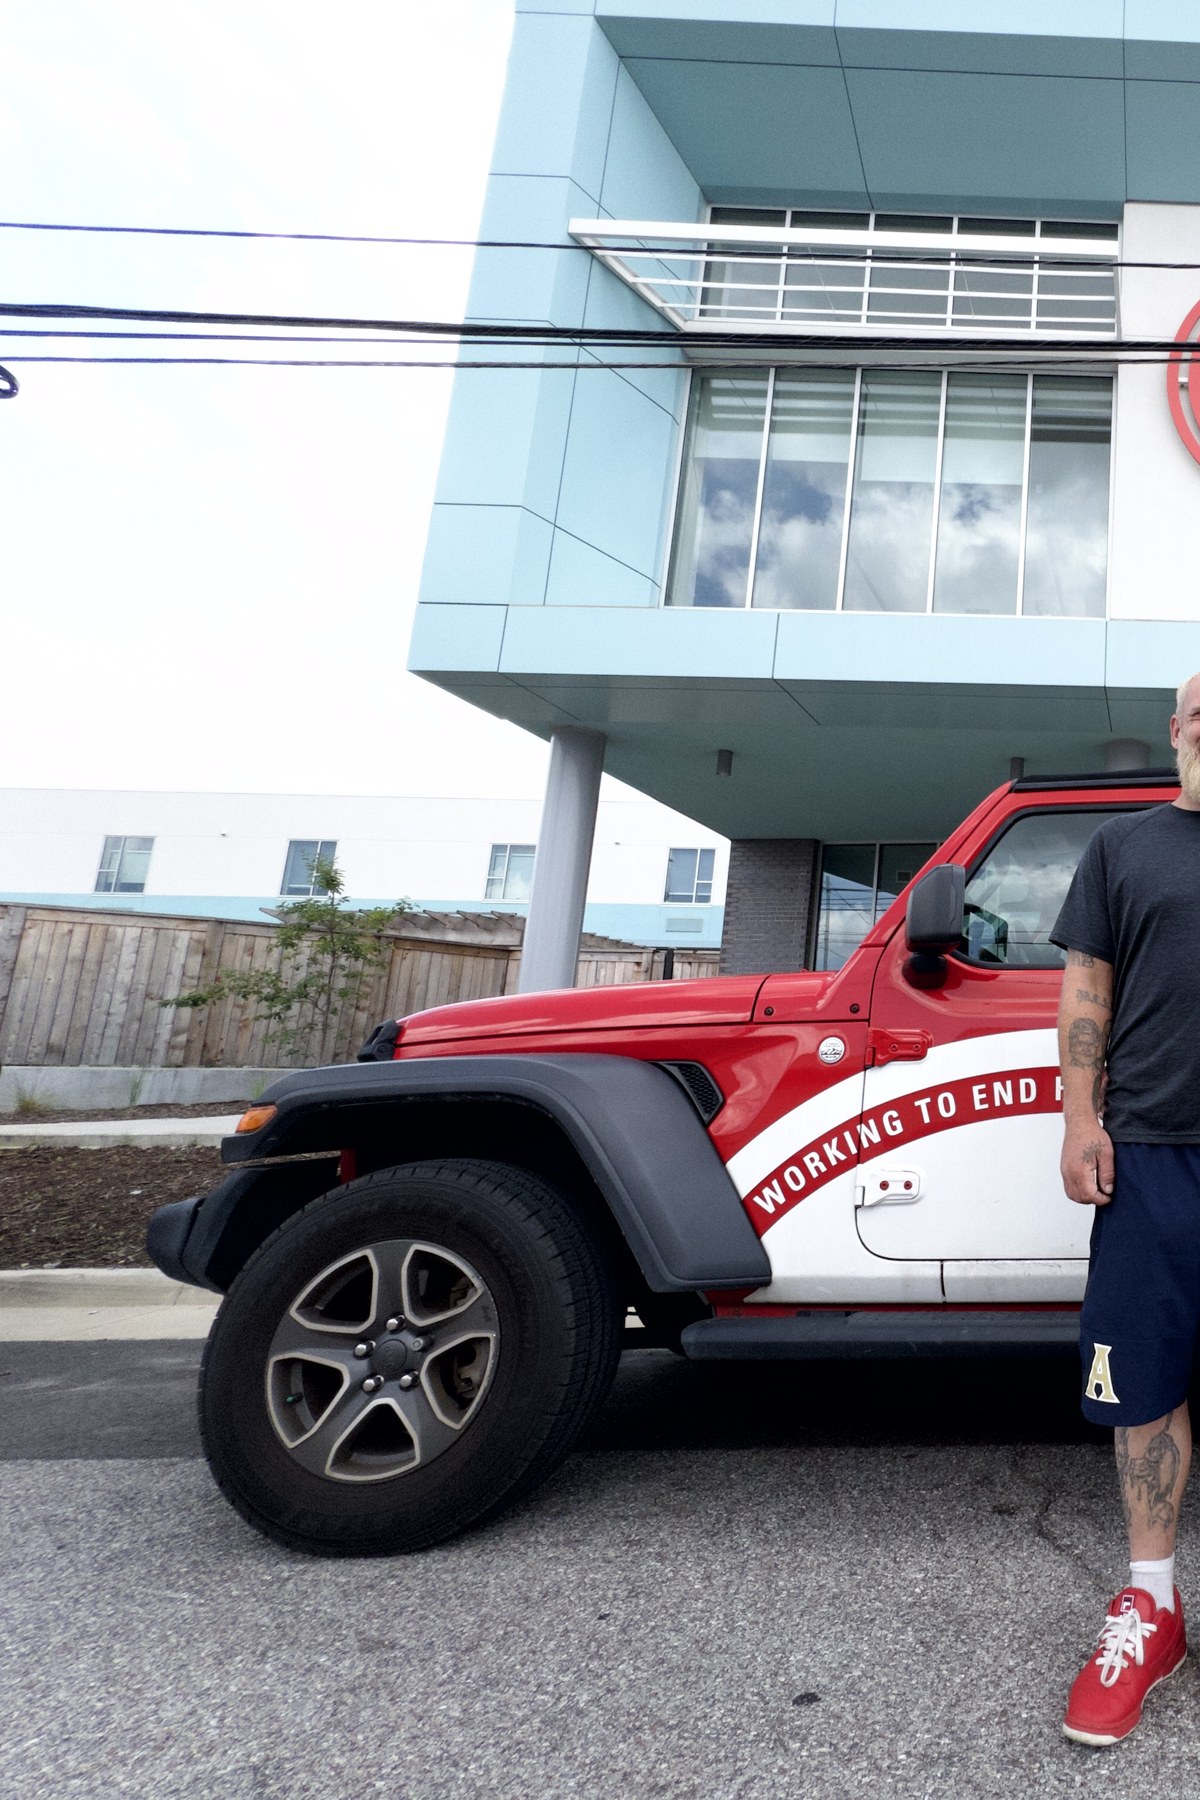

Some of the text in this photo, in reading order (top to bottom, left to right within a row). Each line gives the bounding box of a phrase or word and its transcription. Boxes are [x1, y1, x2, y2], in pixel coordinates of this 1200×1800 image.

[753, 1111, 904, 1215] WORKING
[914, 1092, 957, 1124] TO
[972, 1077, 1038, 1110] END
[1085, 1343, 1120, 1403] A
